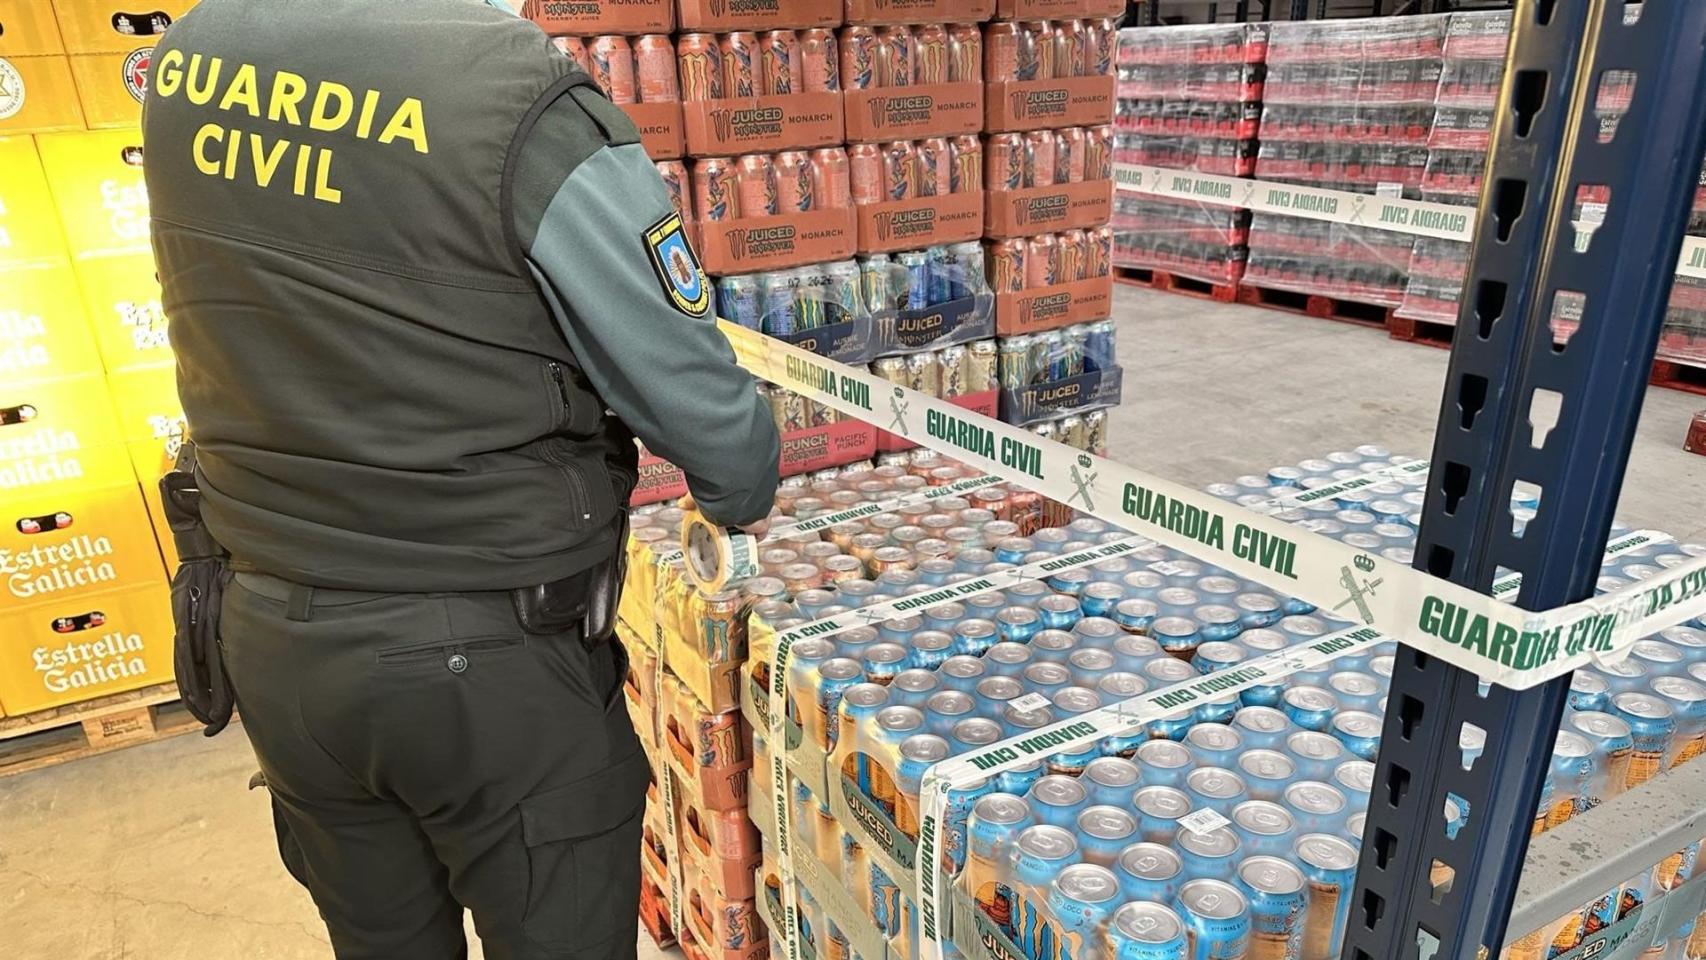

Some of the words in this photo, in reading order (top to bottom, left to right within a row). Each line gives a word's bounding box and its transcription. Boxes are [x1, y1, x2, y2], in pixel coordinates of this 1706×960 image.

[155, 48, 430, 154] GUARDIA
[886, 95, 933, 111] JUICED
[937, 102, 977, 111] MONARCH
[1027, 89, 1068, 104] JUICED
[1072, 95, 1108, 104] MONARCH
[732, 108, 783, 123] JUICED
[789, 113, 833, 123] MONARCH
[639, 126, 670, 134] ARCH
[192, 123, 342, 204] CIVIL
[1029, 195, 1069, 210] JUICED
[1072, 198, 1106, 207] MONARCH
[891, 208, 935, 224] JUICED
[939, 212, 977, 222] MONARCH
[747, 225, 796, 243] JUICED
[801, 229, 843, 240] MONARCH
[1032, 292, 1071, 309] JUICED
[1074, 295, 1107, 304] MONARCH
[898, 314, 943, 332] JUICED
[786, 354, 838, 397] GUARDIA
[841, 379, 873, 411] CIVIL
[1039, 384, 1080, 401] JUICED
[783, 433, 829, 453] PUNCH
[834, 432, 868, 443] PACIFIC
[837, 440, 866, 450] PUNCH
[926, 408, 996, 460] GUARDIA
[1000, 436, 1045, 479] CIVIL
[1122, 482, 1224, 551] GUARDIA
[1232, 523, 1298, 580] CIVIL
[0, 534, 113, 573] Estrella
[1040, 552, 1102, 571] GUARDIA
[1098, 543, 1137, 556] CIVIL
[8, 561, 117, 598] Galicia
[892, 589, 959, 612] GUARDIA
[957, 579, 996, 594] CIVIL
[800, 620, 842, 638] CIVIL
[1418, 595, 1559, 671] GUARDIA
[1564, 613, 1617, 653] CIVIL
[32, 632, 145, 671] Estrella
[1309, 633, 1352, 656] CIVIL
[43, 659, 147, 692] Galicia
[1192, 666, 1267, 690] GUARDIA
[1148, 690, 1198, 709] CIVIL
[1013, 721, 1098, 755] GUARDIA
[966, 748, 1019, 771] CIVIL
[849, 796, 893, 846] JUICED
[924, 815, 936, 896] GUARDIA
[923, 900, 936, 942] CIVIL
